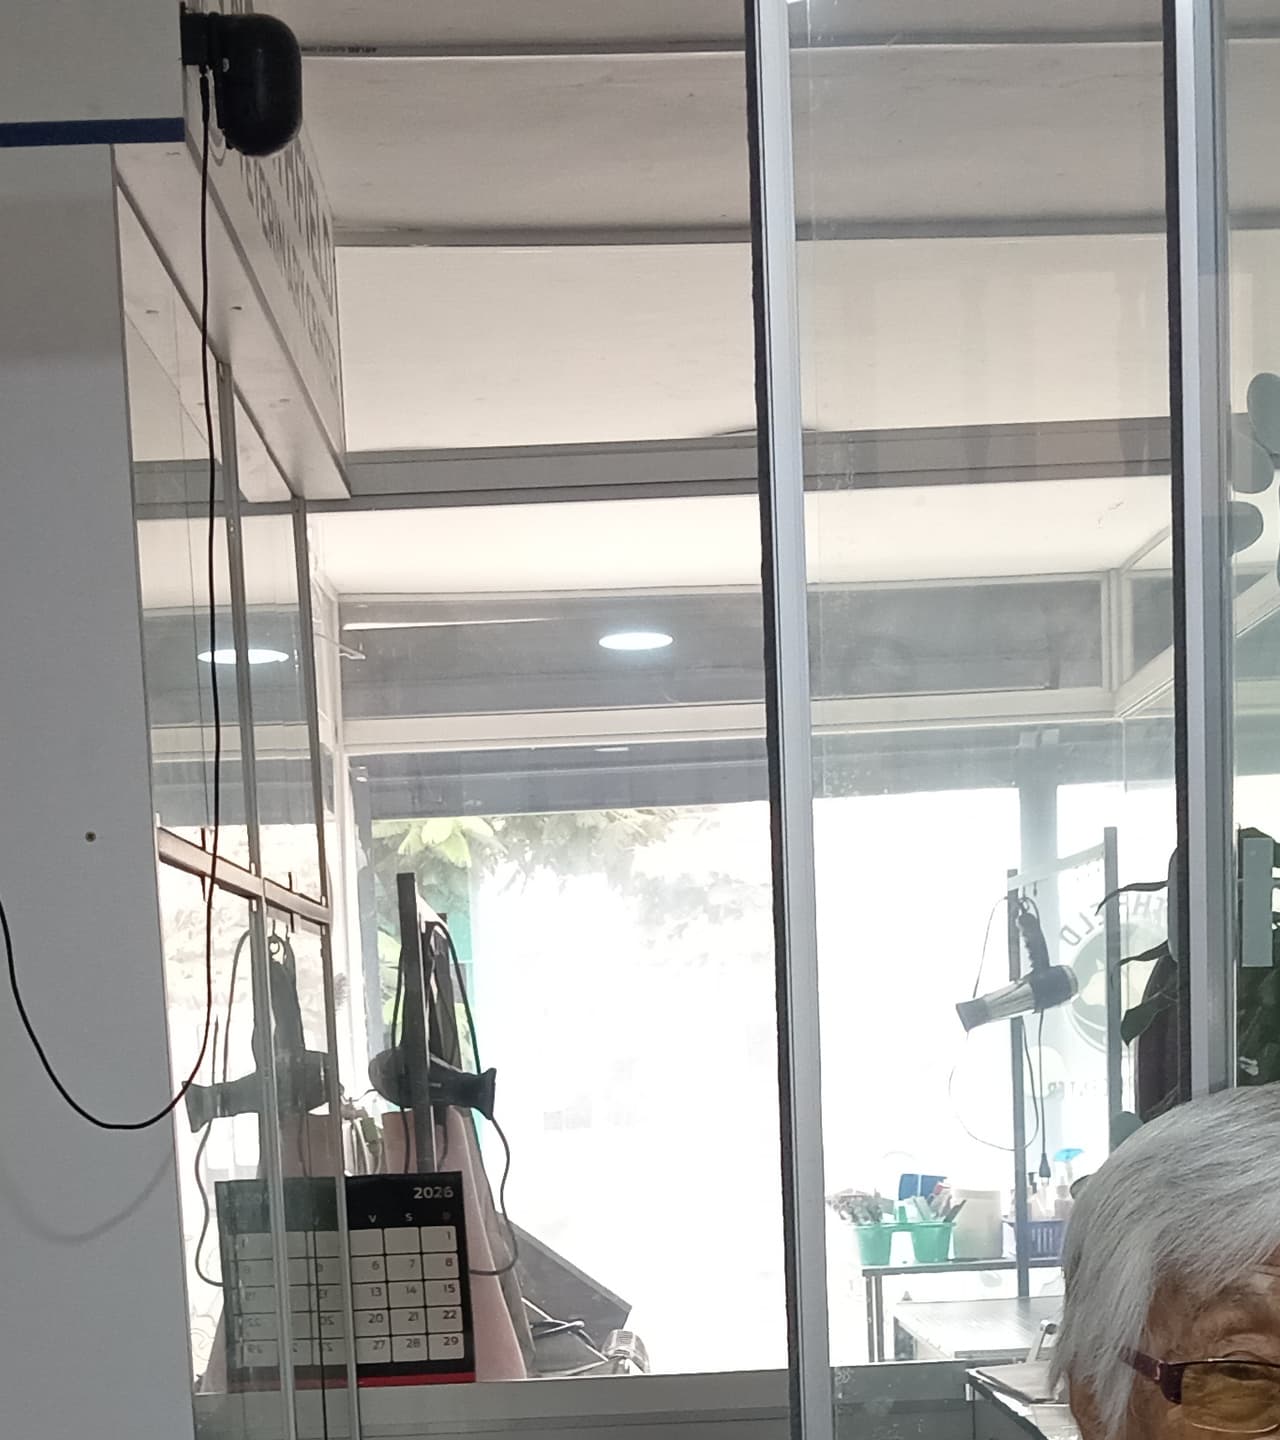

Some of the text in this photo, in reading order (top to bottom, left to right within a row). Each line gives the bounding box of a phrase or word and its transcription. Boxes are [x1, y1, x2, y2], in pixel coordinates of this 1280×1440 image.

[413, 1186, 454, 1200] 2026
[405, 1212, 414, 1222] S
[372, 1261, 380, 1271] 6
[409, 1259, 416, 1269] 7
[370, 1284, 456, 1297] 13 14 15
[368, 1310, 457, 1323] 20 21 22
[373, 1340, 385, 1350] 27
[443, 1336, 459, 1346] 29
